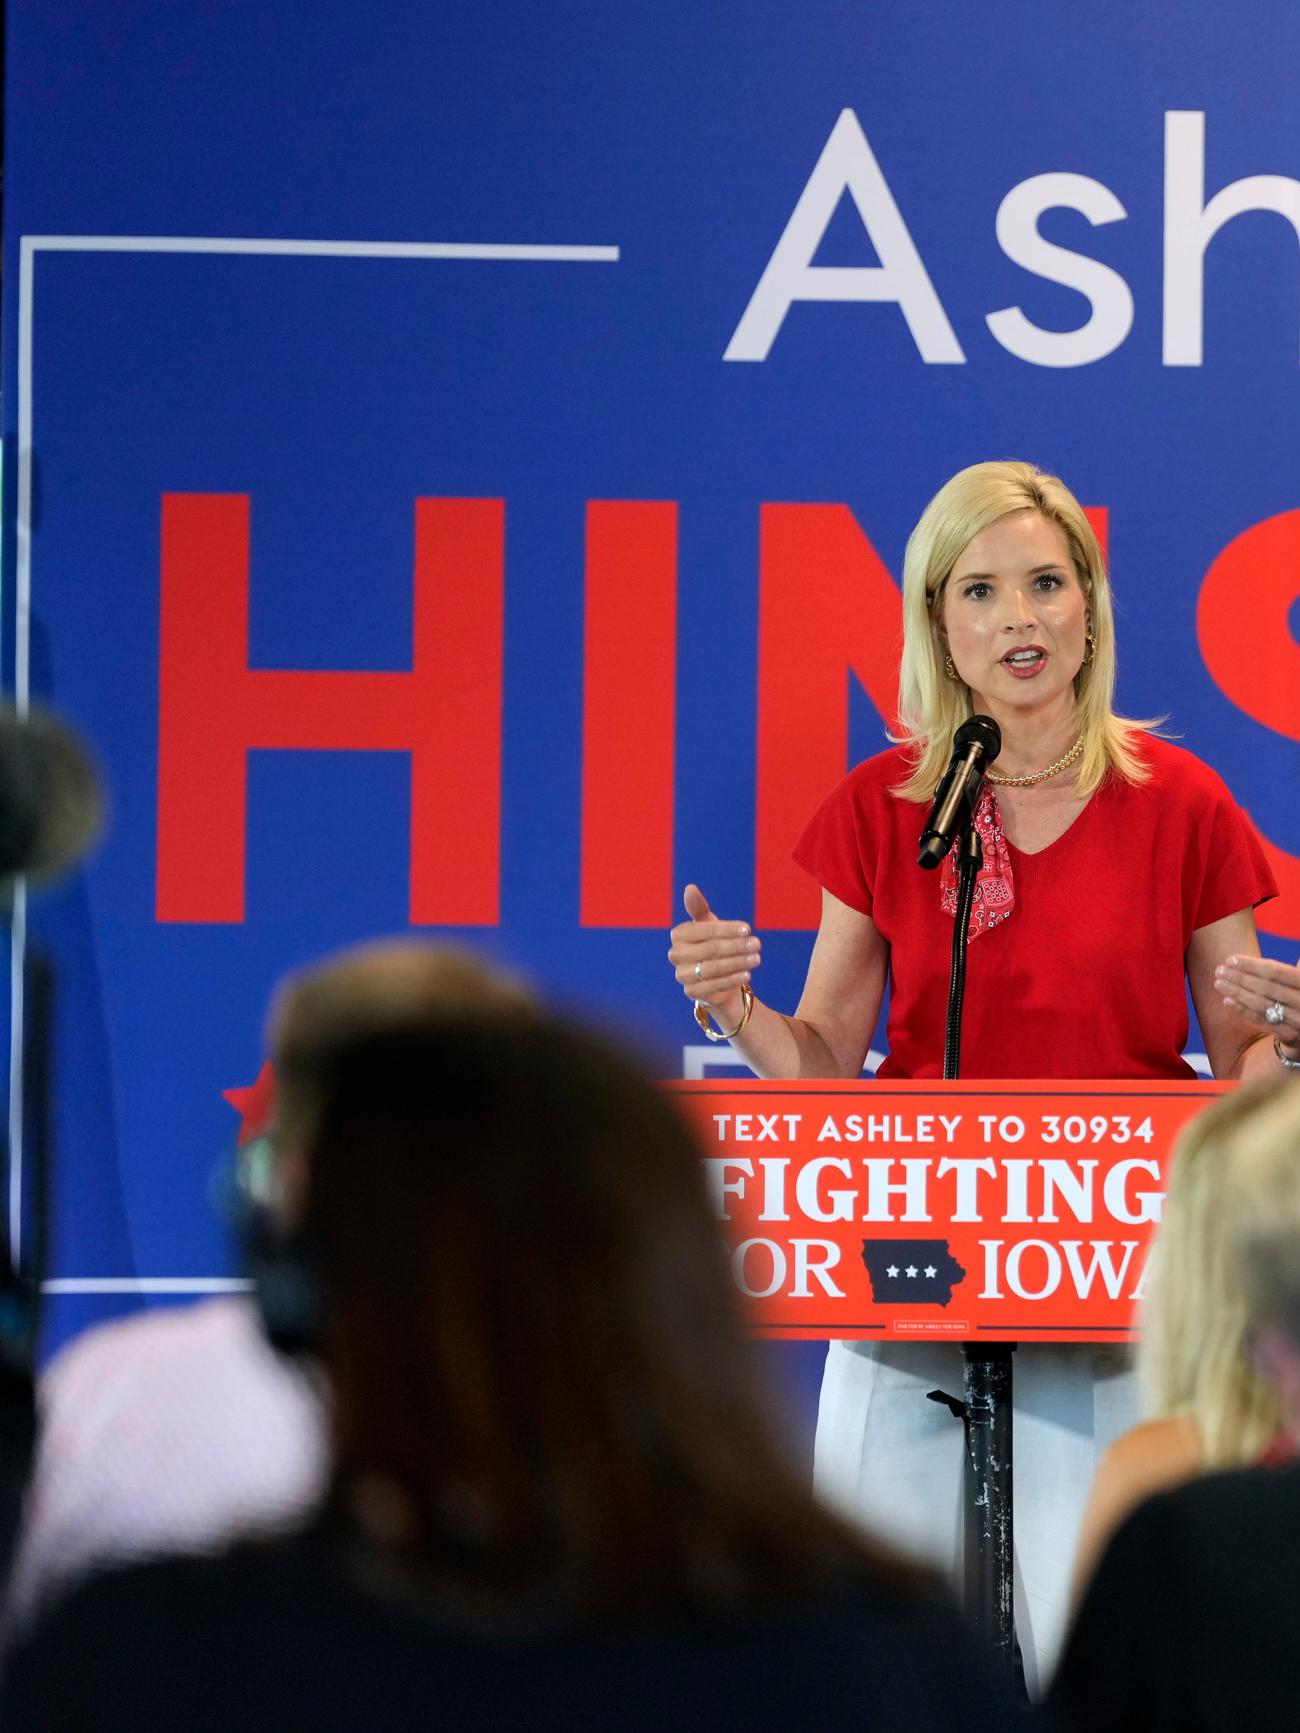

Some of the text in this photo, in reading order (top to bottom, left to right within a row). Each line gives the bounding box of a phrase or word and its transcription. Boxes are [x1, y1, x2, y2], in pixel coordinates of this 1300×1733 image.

[712, 1113, 1155, 1144] TEXT ASHLEY TO 30934
[703, 1156, 1167, 1225] FIGHTING
[729, 1237, 847, 1298] OR
